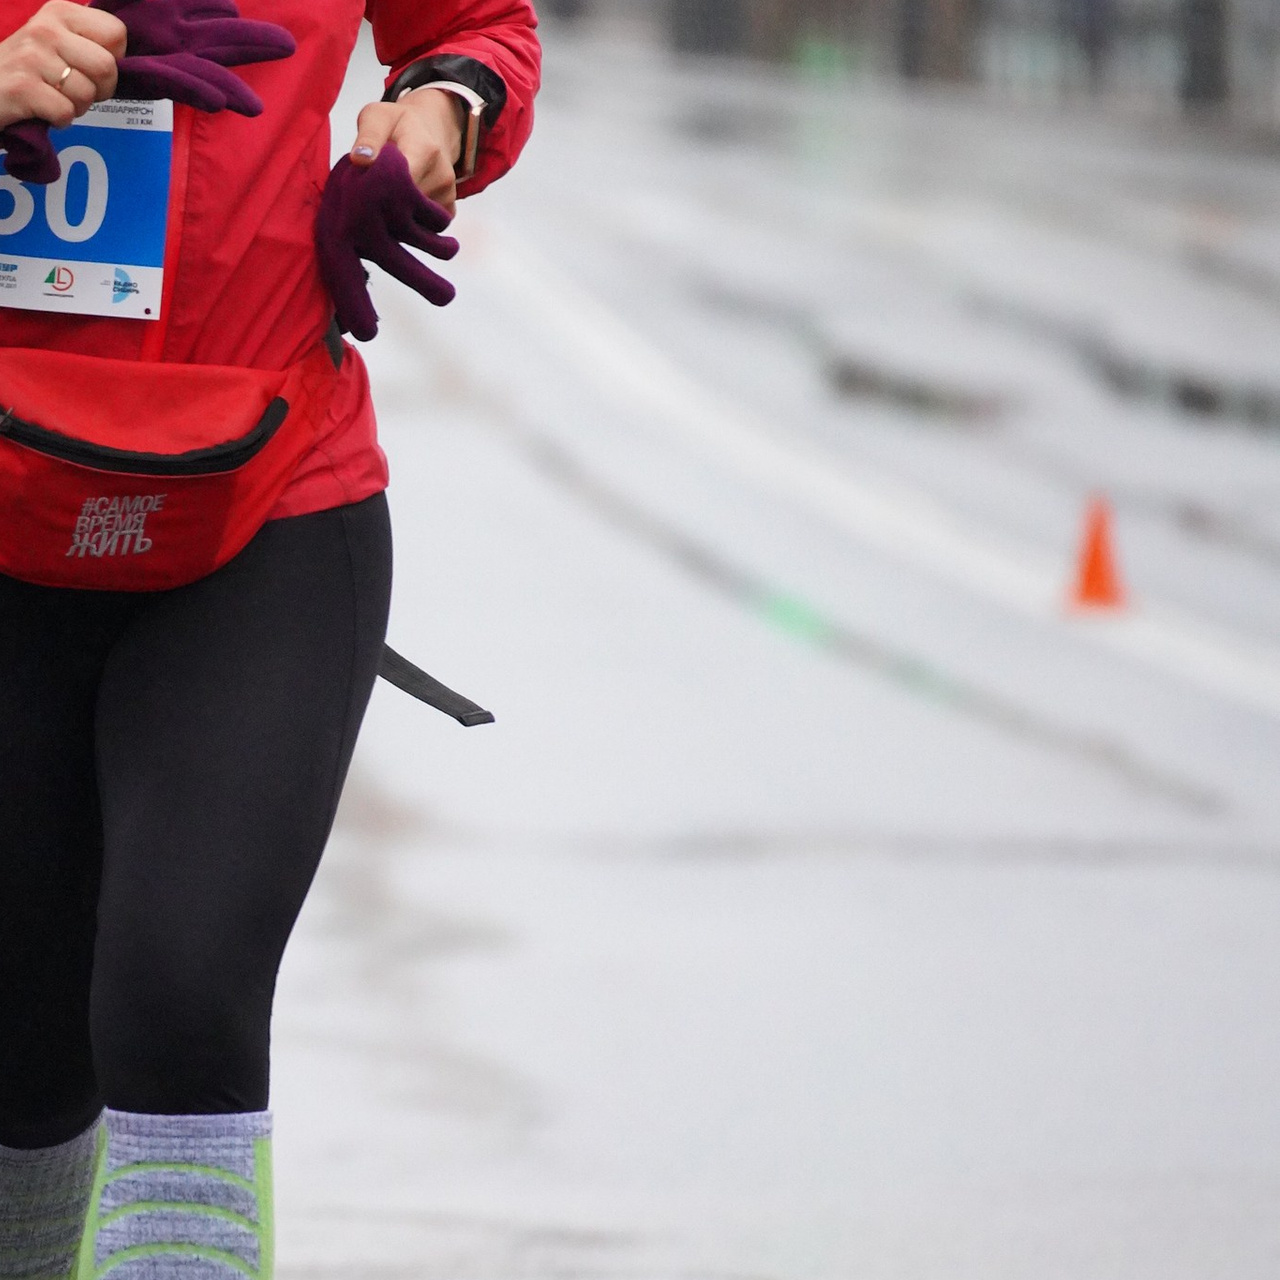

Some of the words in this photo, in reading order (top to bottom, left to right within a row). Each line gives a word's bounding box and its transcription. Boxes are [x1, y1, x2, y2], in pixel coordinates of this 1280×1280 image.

[88, 104, 154, 115] ОЛУМАРАФОН
[81, 493, 168, 516] #САМОЕ
[74, 512, 147, 534] ВРЕМЯ
[65, 529, 153, 558] ЖИТЬ
